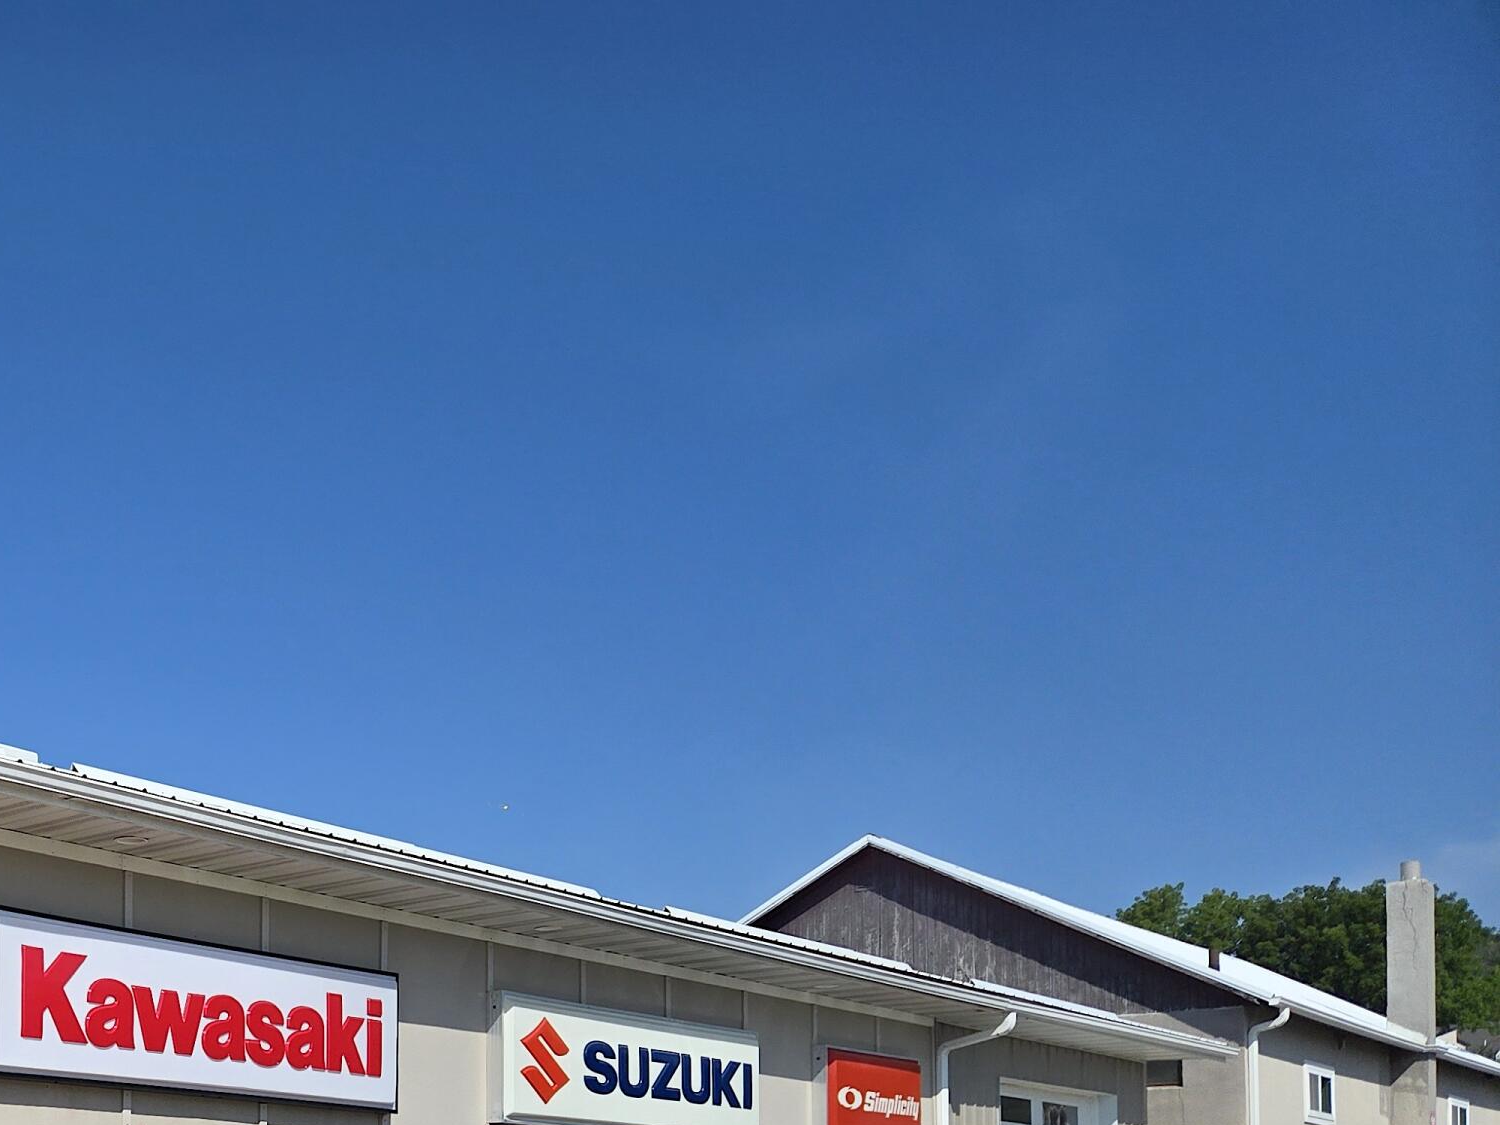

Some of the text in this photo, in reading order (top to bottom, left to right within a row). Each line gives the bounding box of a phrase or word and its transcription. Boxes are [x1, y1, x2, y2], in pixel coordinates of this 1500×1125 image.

[20, 944, 383, 1078] Kawasaki
[583, 1040, 753, 1110] SUZUKI
[863, 1090, 920, 1121] Simplicity
